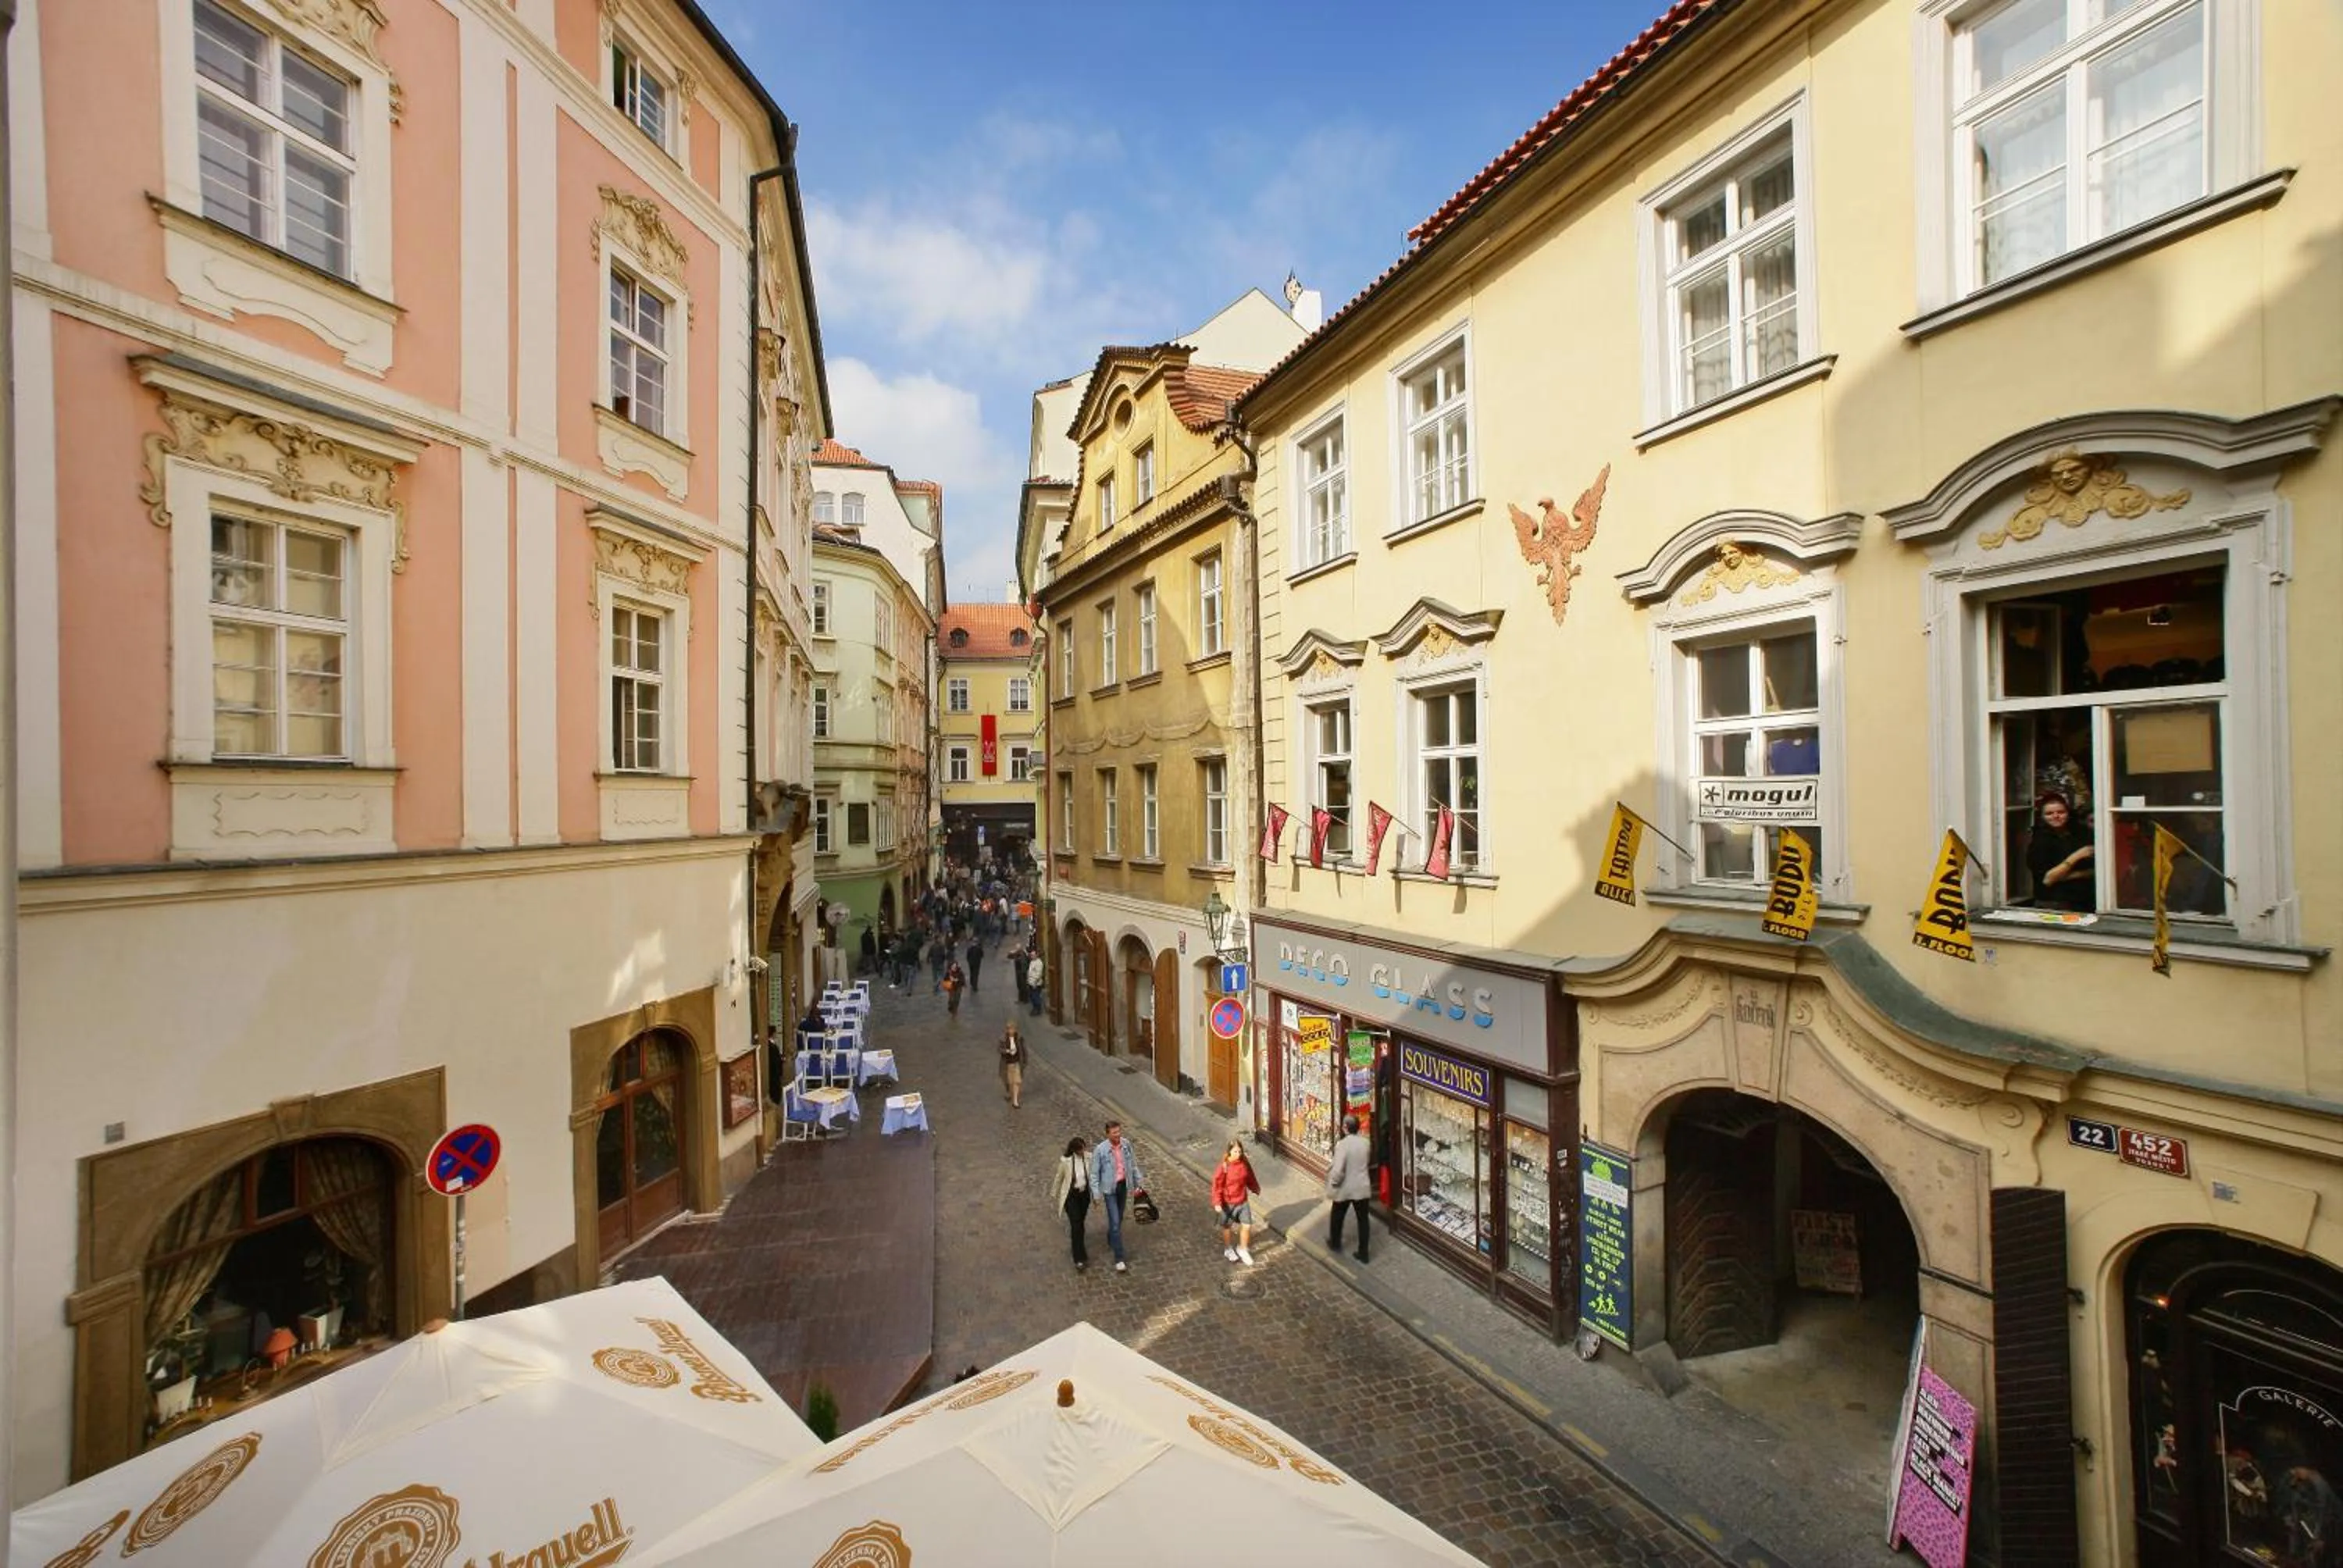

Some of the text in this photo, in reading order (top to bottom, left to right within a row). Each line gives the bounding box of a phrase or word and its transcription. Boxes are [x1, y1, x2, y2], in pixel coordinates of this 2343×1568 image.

[1727, 786, 1813, 805] mogul
[1769, 924, 1806, 939] FLOOR
[1278, 942, 1493, 1028] DECO GLASS
[1405, 1049, 1483, 1096] SOUVENIRS
[2078, 1126, 2105, 1145] 22
[2130, 1133, 2172, 1156] 452
[2258, 1390, 2334, 1427] GALERIE
